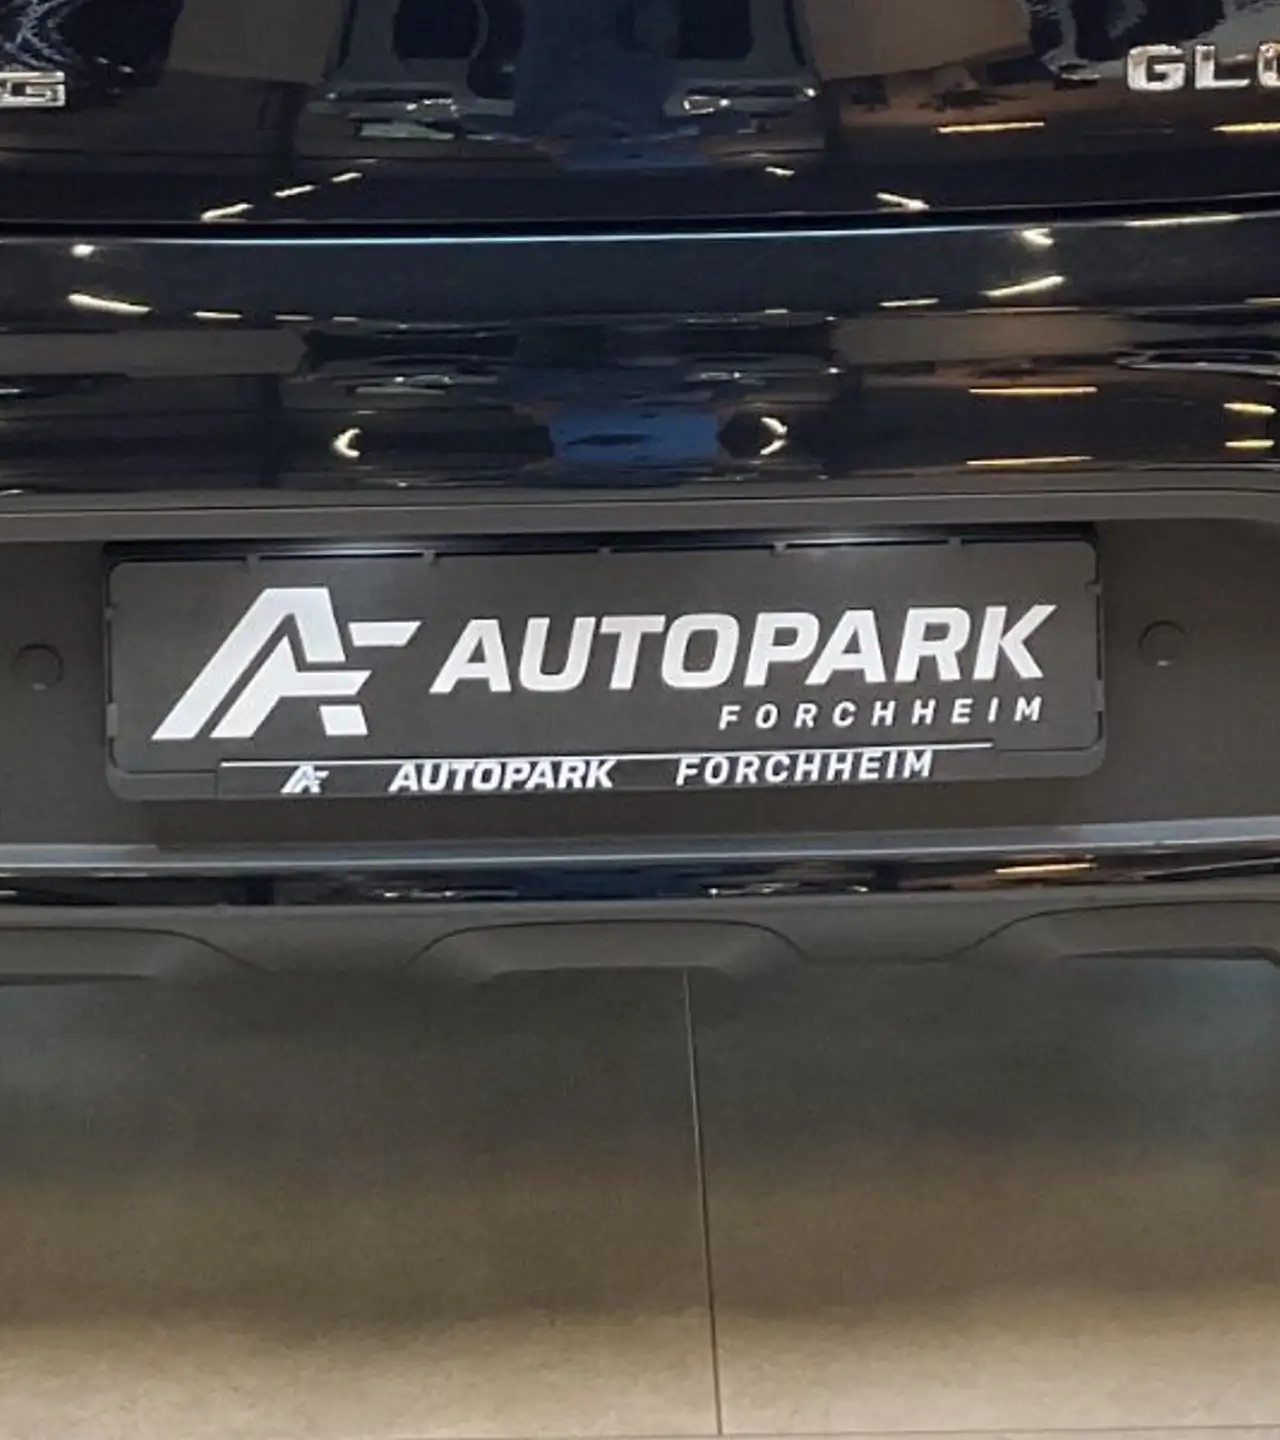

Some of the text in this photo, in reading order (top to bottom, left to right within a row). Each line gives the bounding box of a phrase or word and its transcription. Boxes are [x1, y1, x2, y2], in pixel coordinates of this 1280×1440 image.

[428, 603, 1058, 695] AUTOPARK
[718, 695, 1043, 731] FORCHHEIM
[388, 756, 616, 793] AUTOPARK
[674, 748, 934, 787] FORCHHEIM
